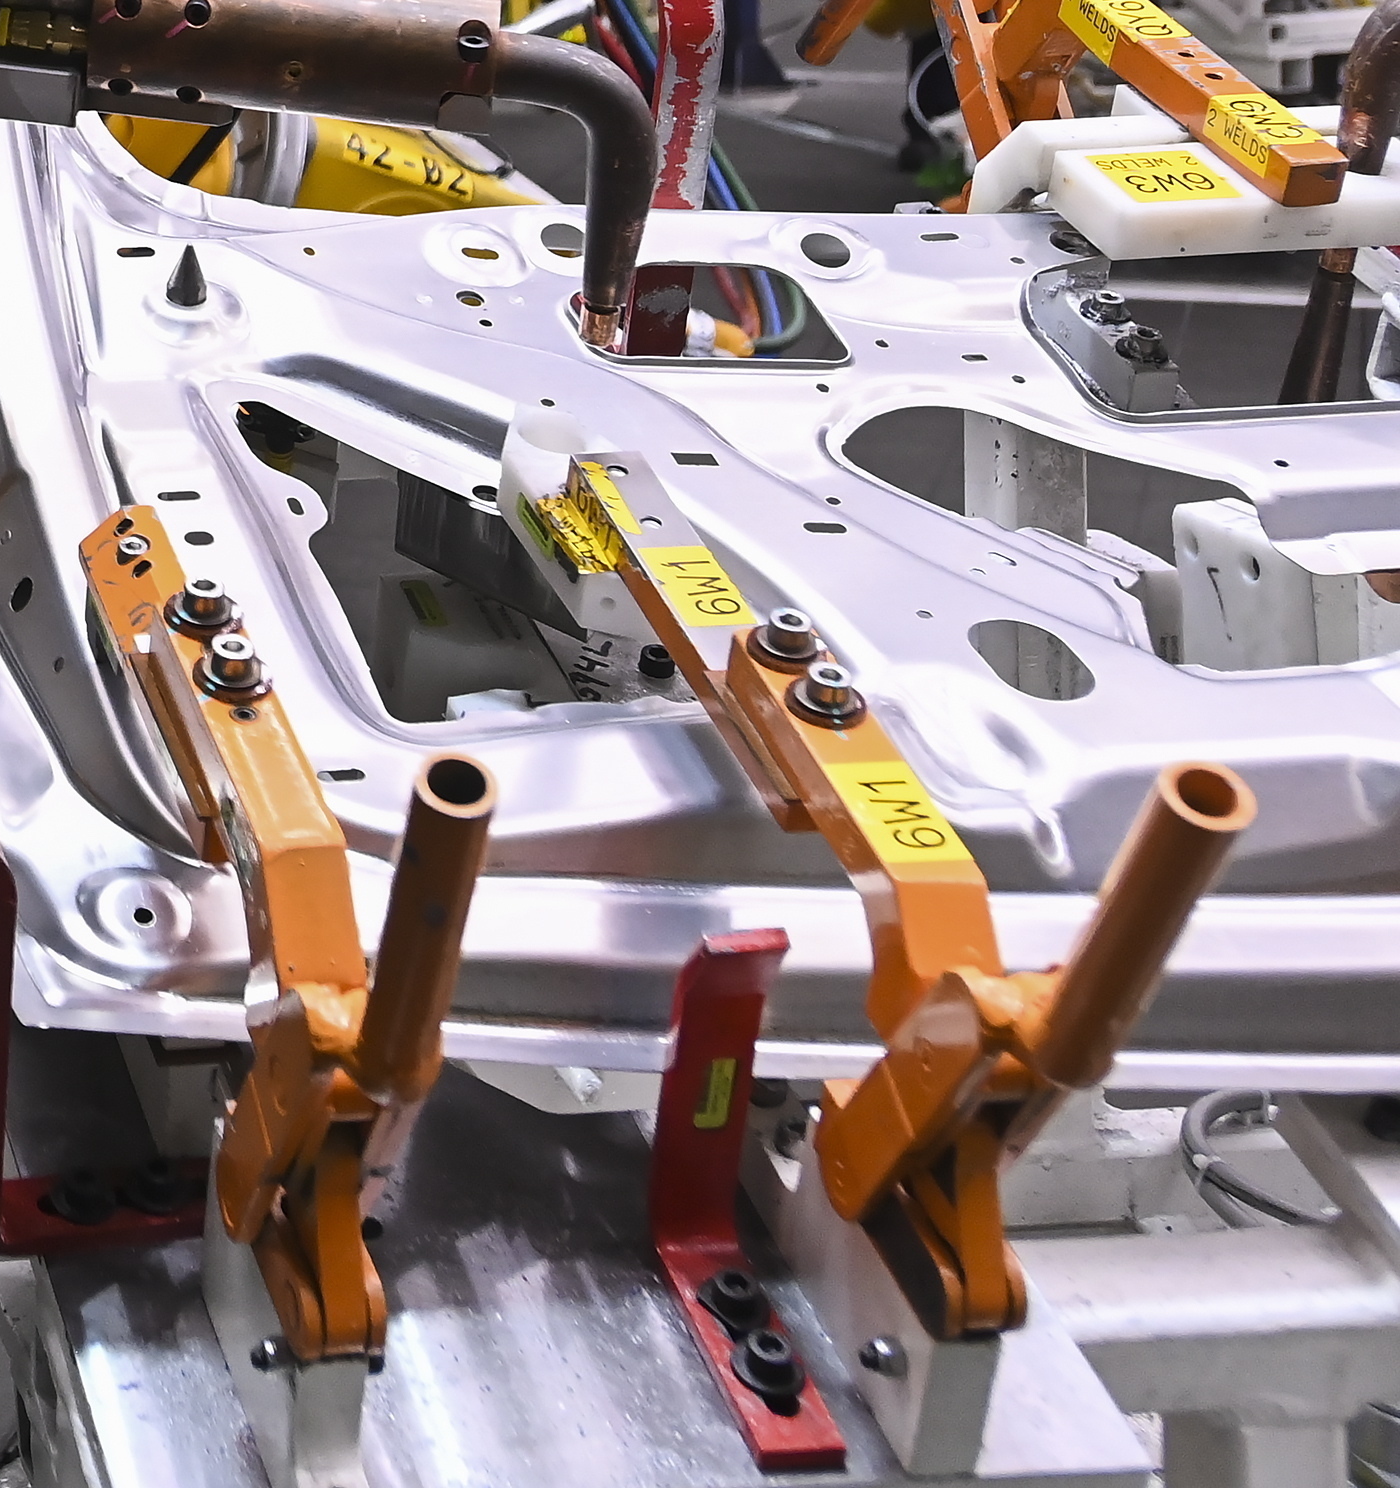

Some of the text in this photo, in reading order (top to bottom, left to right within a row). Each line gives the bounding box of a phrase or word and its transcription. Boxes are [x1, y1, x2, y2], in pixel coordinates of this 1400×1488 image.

[1206, 108, 1269, 166] 2 WELDS
[1228, 99, 1304, 141] 6W3
[1095, 155, 1199, 172] 2 WELDS
[1124, 171, 1217, 194] 6W3
[661, 559, 742, 616] 6W1
[857, 780, 946, 849] 6W1
